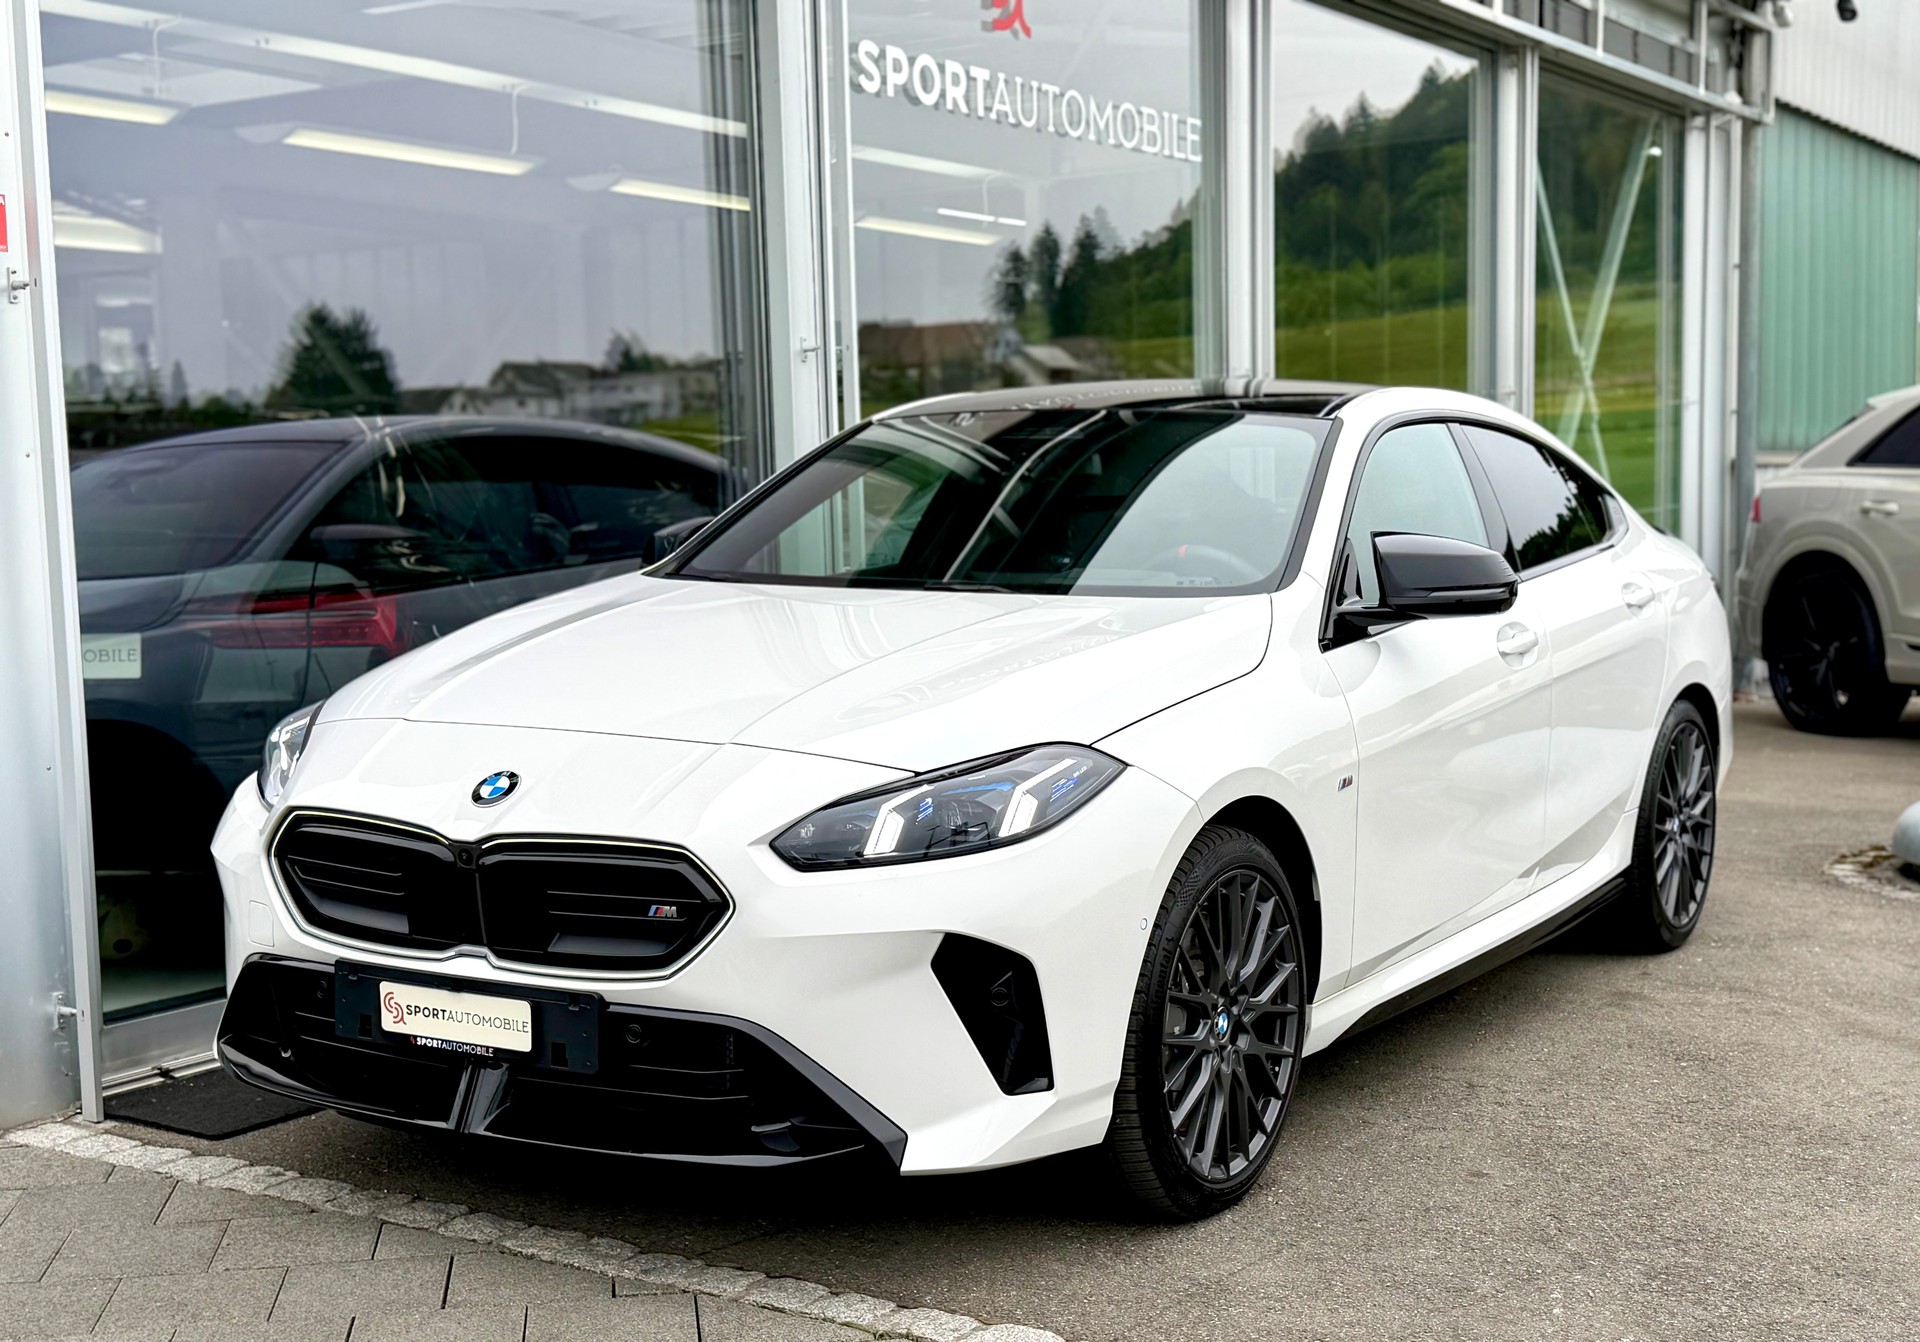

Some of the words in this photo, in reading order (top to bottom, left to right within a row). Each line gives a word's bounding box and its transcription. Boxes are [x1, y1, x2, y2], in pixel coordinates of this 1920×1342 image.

[857, 39, 1204, 163] SPORTAUTOMOBILE
[405, 1003, 530, 1034] SPORTAUTOMOBILE
[416, 1036, 495, 1057] SPORTAUTOMOBILE
